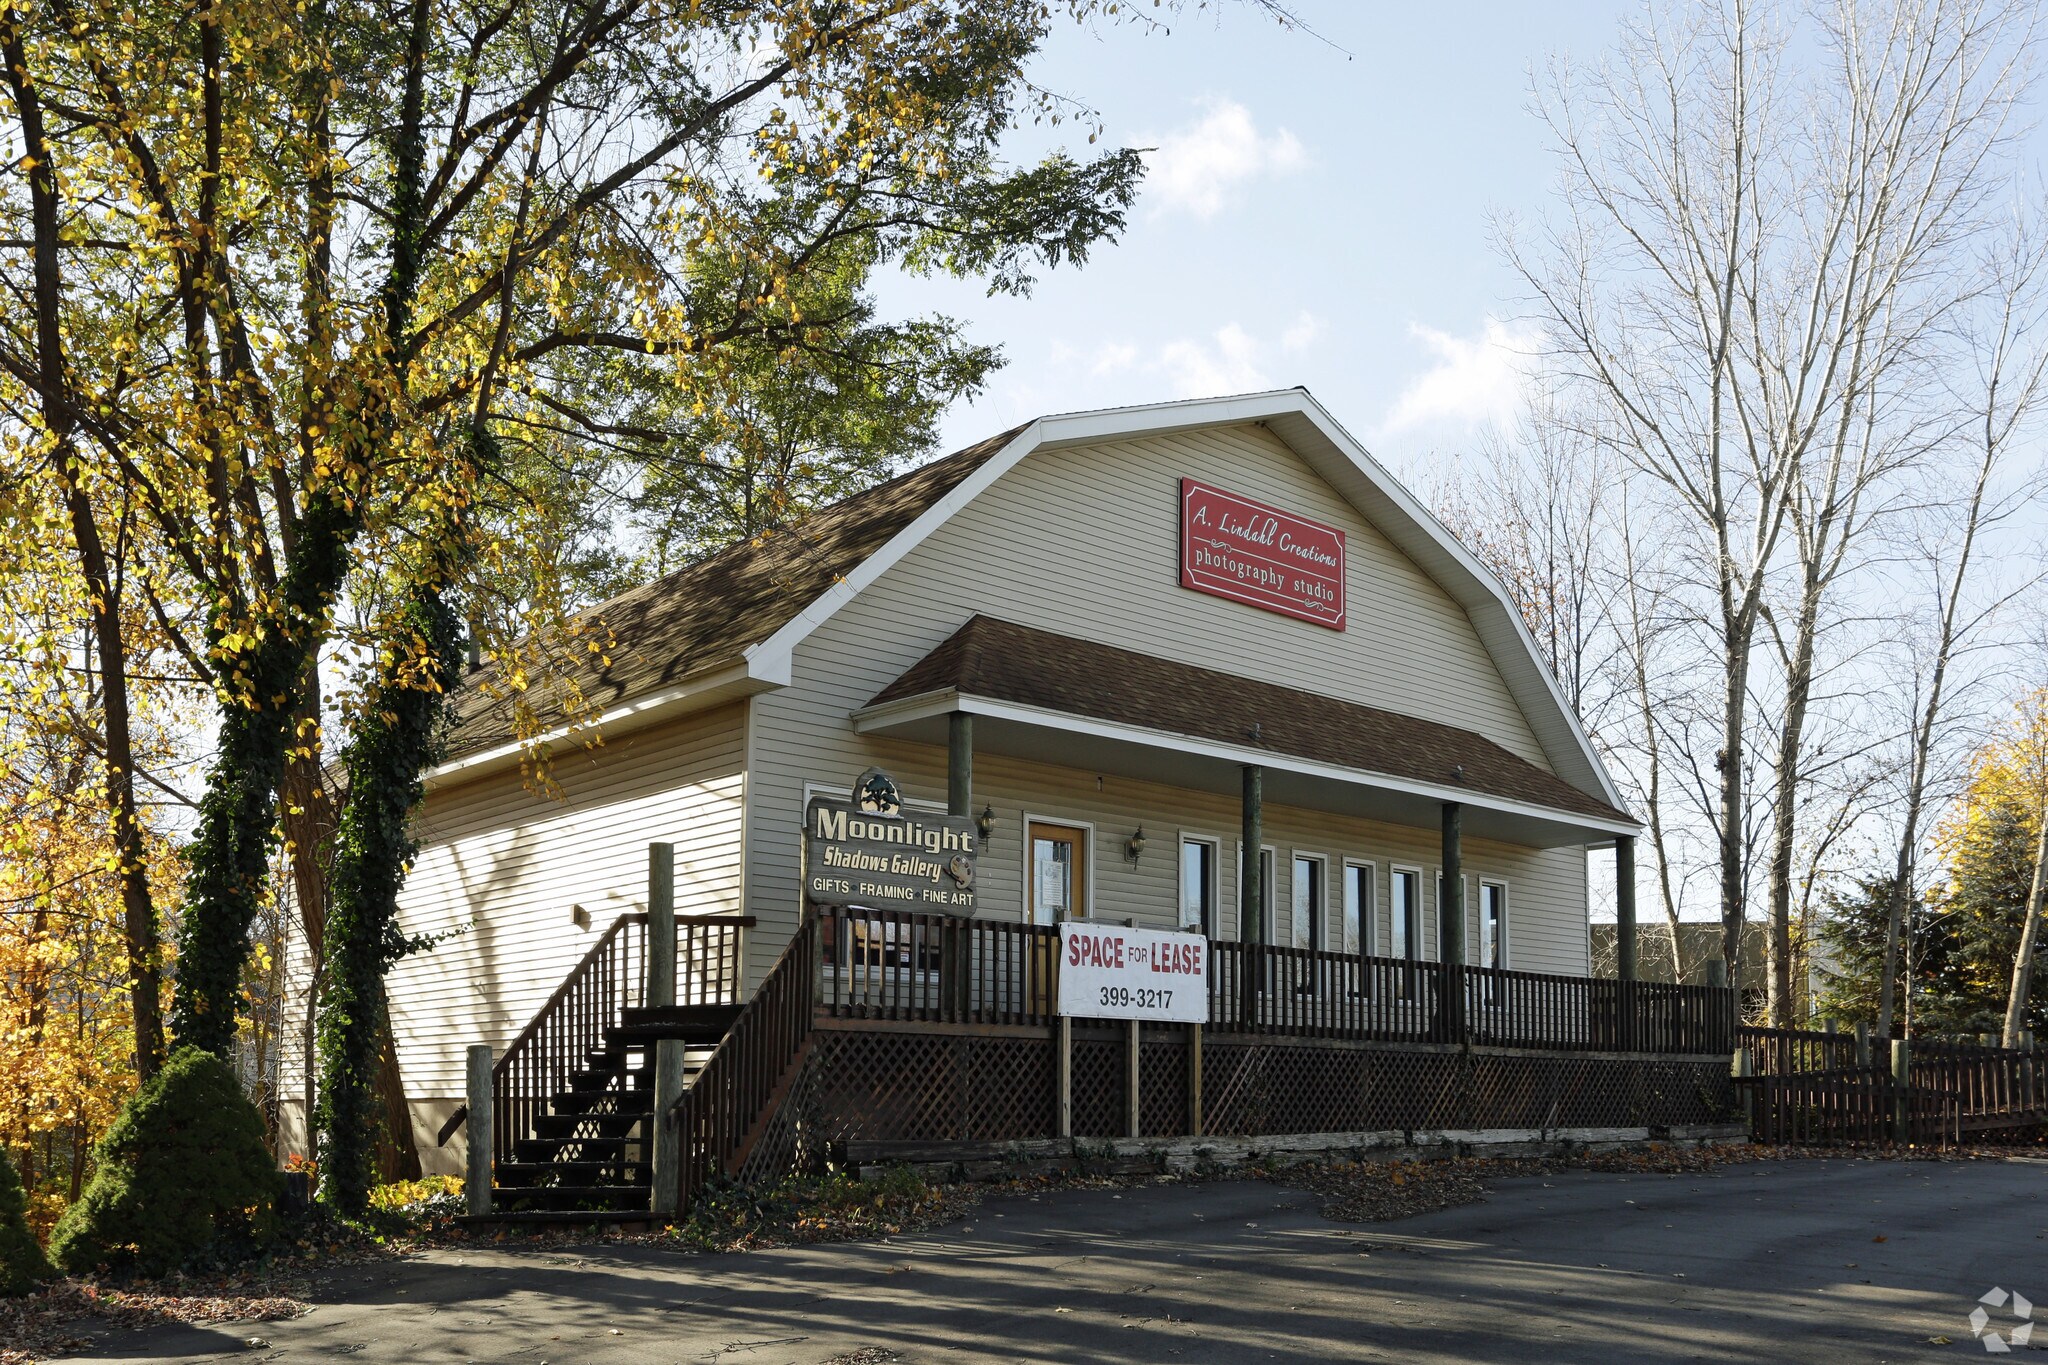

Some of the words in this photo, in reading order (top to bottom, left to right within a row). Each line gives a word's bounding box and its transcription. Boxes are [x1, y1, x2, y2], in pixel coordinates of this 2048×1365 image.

[1193, 506, 1211, 527] A.
[1219, 513, 1278, 546] Lindahl
[1279, 533, 1337, 567] Creations
[1196, 548, 1285, 590] photography
[1294, 579, 1334, 601] studio
[817, 808, 973, 854] Moonlight
[823, 846, 889, 872] Shadows
[891, 854, 942, 883] Gallery
[813, 877, 850, 894] GIFTS
[859, 883, 914, 900] FRAMING
[922, 889, 948, 904] FINE
[950, 893, 974, 906] ART
[1068, 933, 1125, 969] SPACE
[1128, 946, 1148, 963] FOR
[1151, 942, 1202, 975] LEASE
[1100, 986, 1173, 1009] 399-3217
